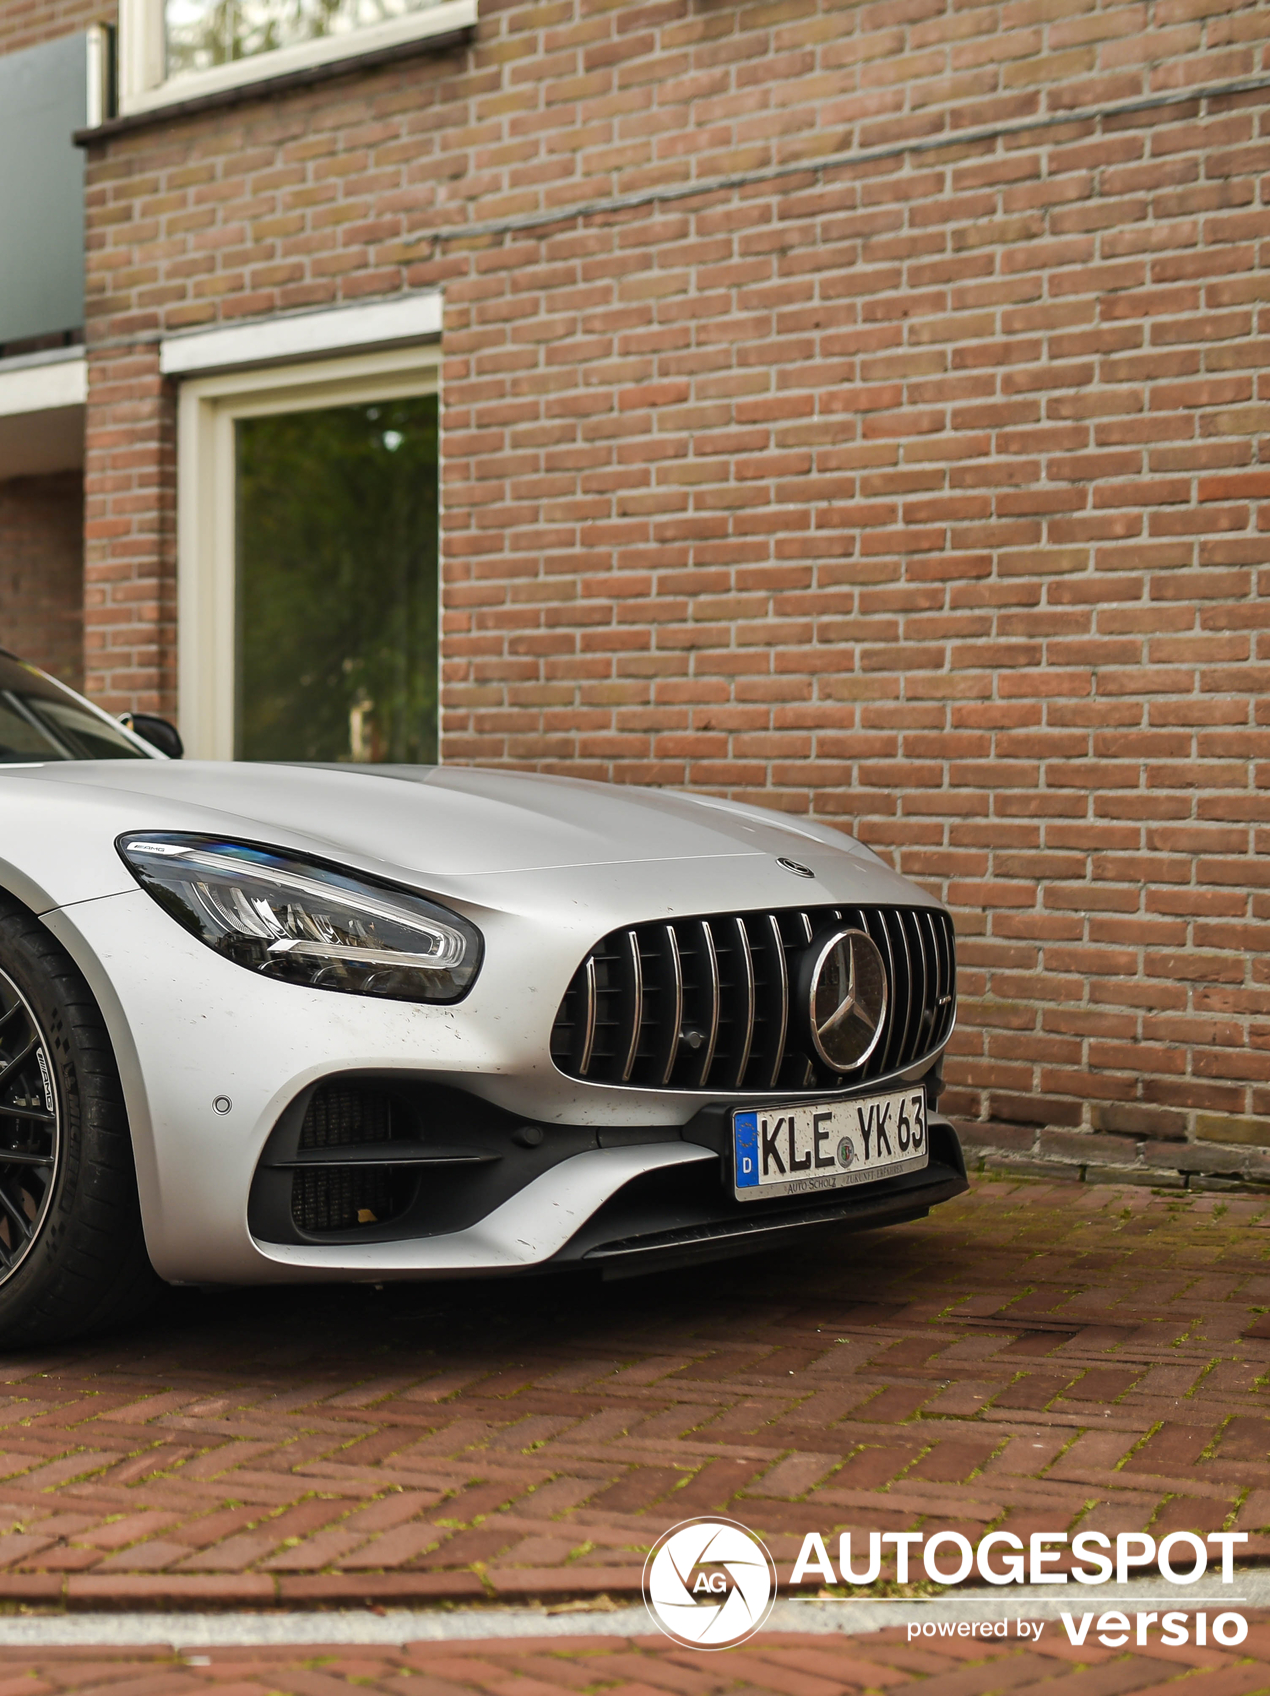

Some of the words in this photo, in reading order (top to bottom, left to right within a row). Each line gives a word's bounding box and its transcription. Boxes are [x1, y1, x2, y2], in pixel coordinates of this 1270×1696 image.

[762, 1111, 836, 1176] KLE
[857, 1101, 892, 1160] YK
[897, 1095, 924, 1152] 63
[742, 1156, 752, 1174] D
